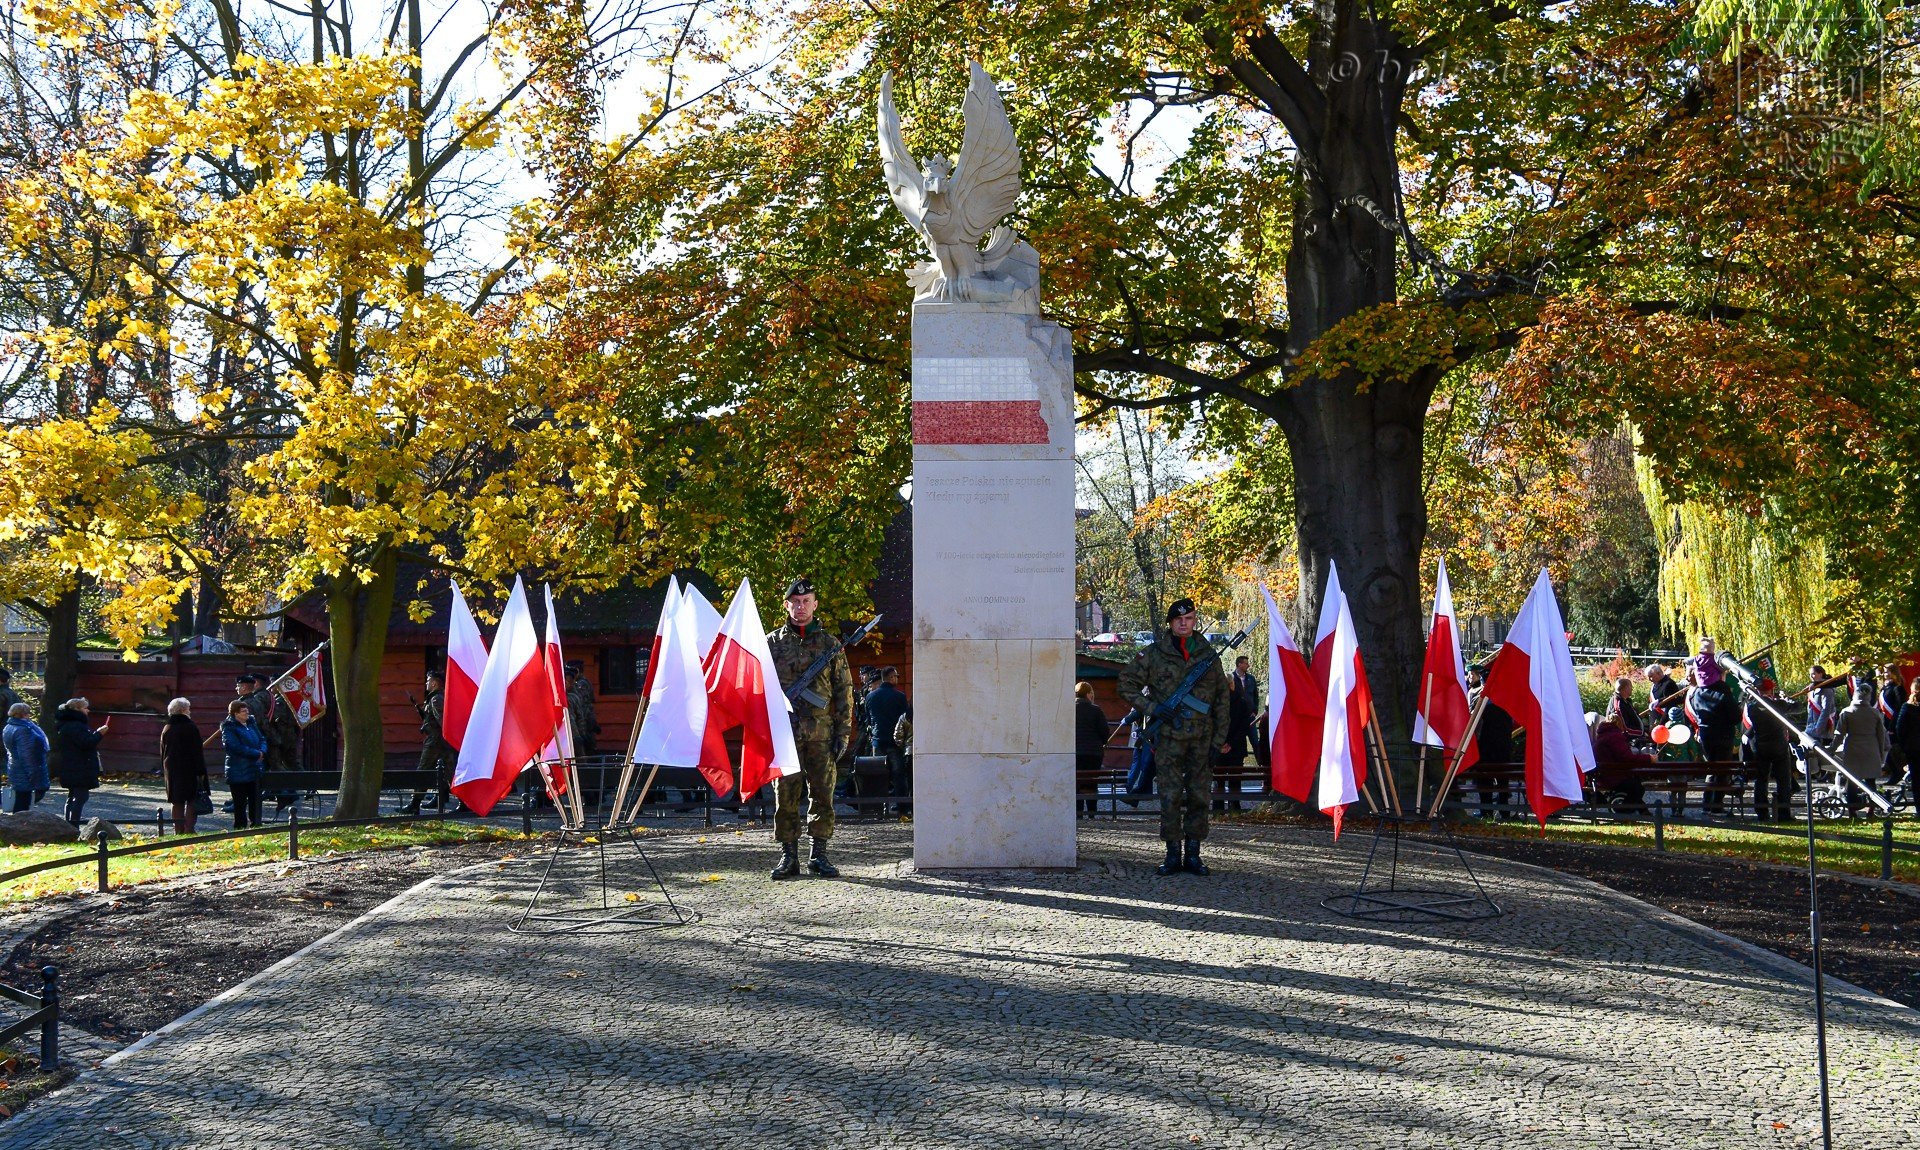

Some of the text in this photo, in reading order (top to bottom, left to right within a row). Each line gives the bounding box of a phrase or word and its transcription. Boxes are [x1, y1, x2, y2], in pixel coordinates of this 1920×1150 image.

[962, 476, 995, 486] Polska
[998, 475, 1014, 486] nie
[925, 491, 954, 504] Kiedy
[956, 492, 972, 504] my
[963, 596, 1026, 604] ANNO DOMINI 2018
